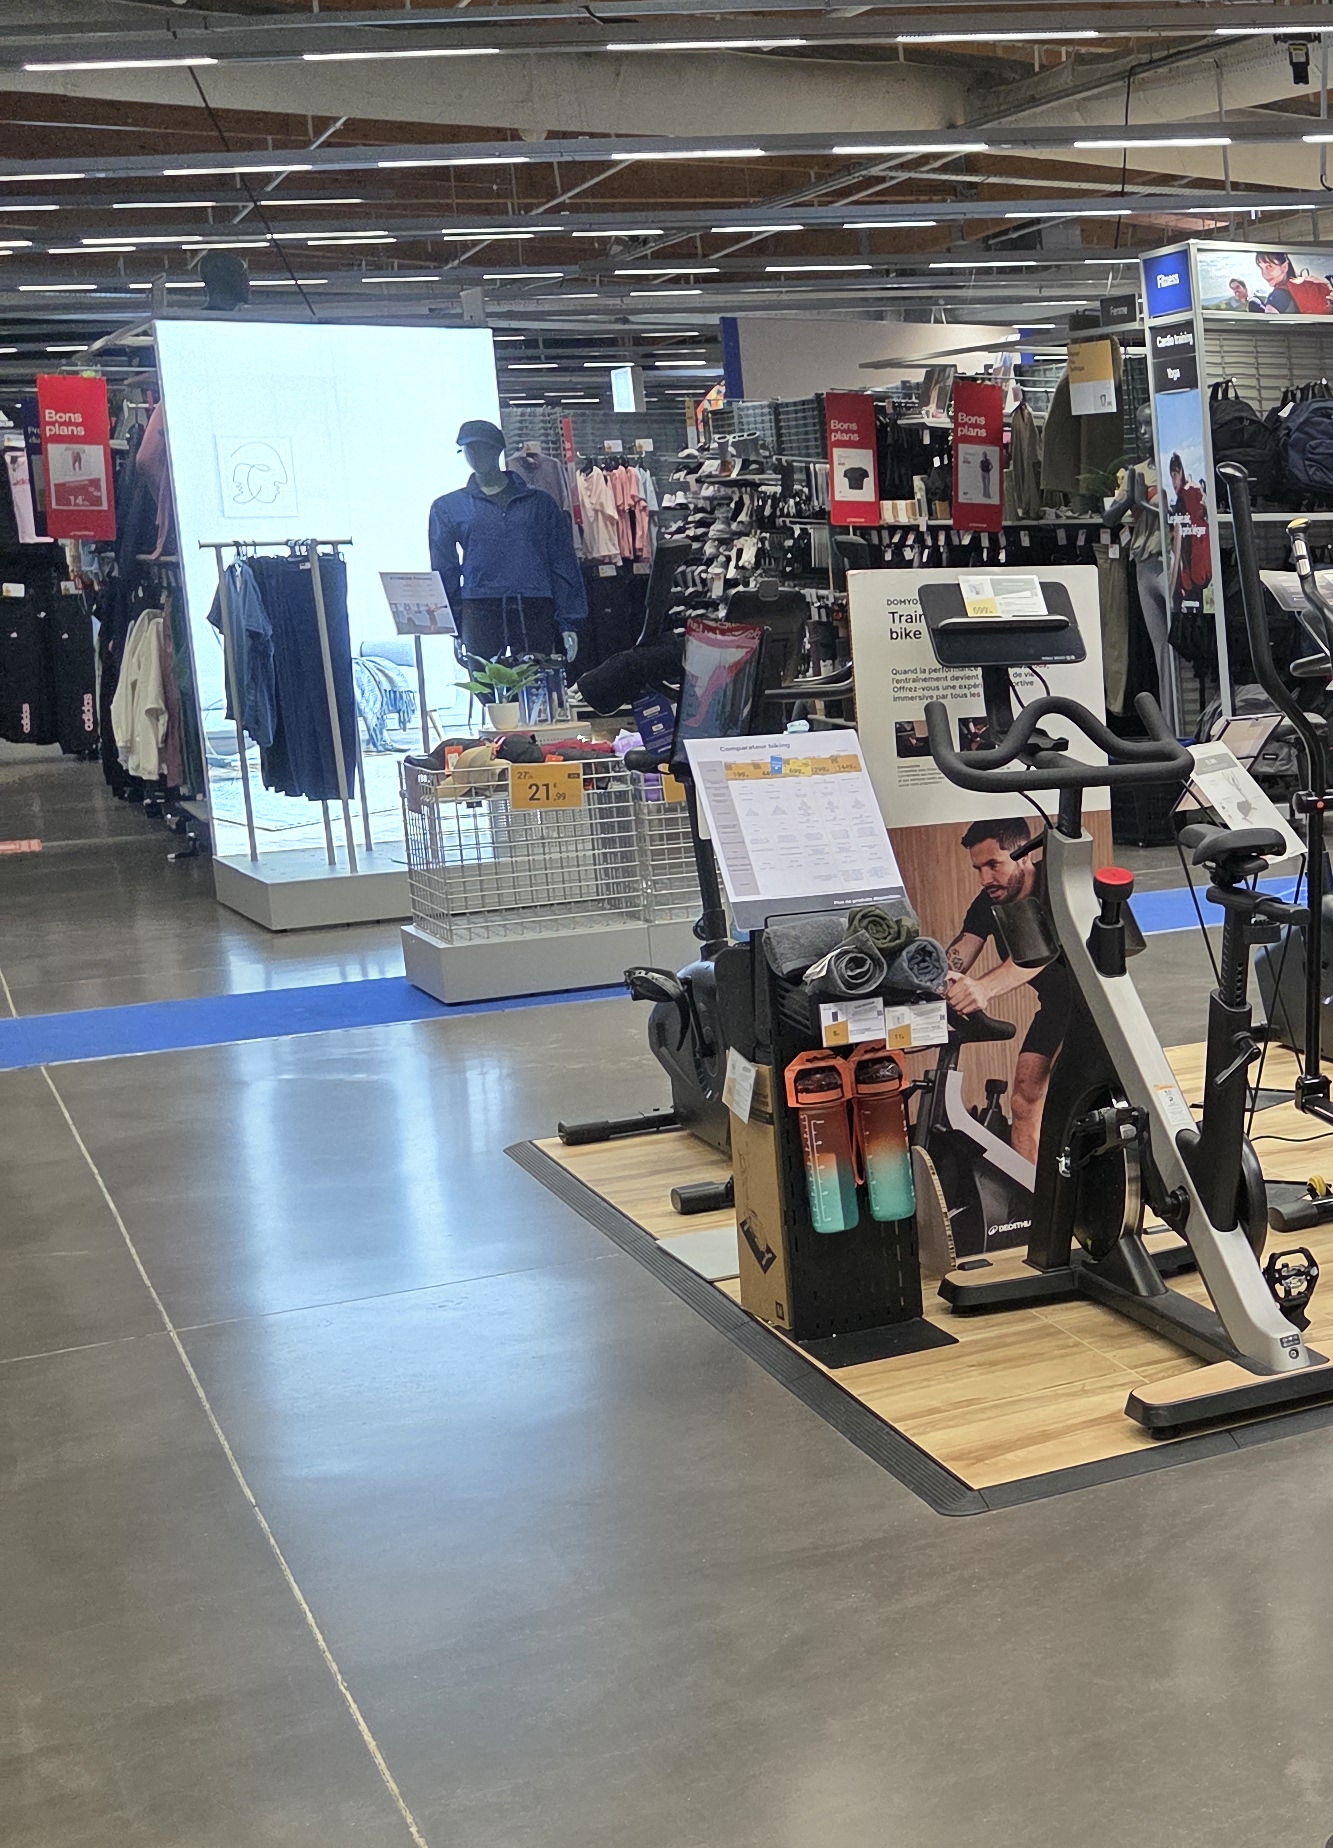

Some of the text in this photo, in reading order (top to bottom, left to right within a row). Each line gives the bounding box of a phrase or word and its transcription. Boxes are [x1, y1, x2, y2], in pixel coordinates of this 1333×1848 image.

[45, 409, 82, 422] Bons
[958, 413, 985, 425] Bons
[46, 423, 85, 437] plans
[831, 420, 857, 431] Bons
[958, 425, 986, 437] plans
[831, 431, 859, 442] plans
[886, 598, 920, 606] DOMYO
[889, 627, 922, 640] bike
[891, 668, 918, 676] Quand
[950, 673, 979, 682] devient
[892, 685, 940, 693] Offrez-vous
[936, 693, 948, 701] par
[950, 691, 968, 699] tous
